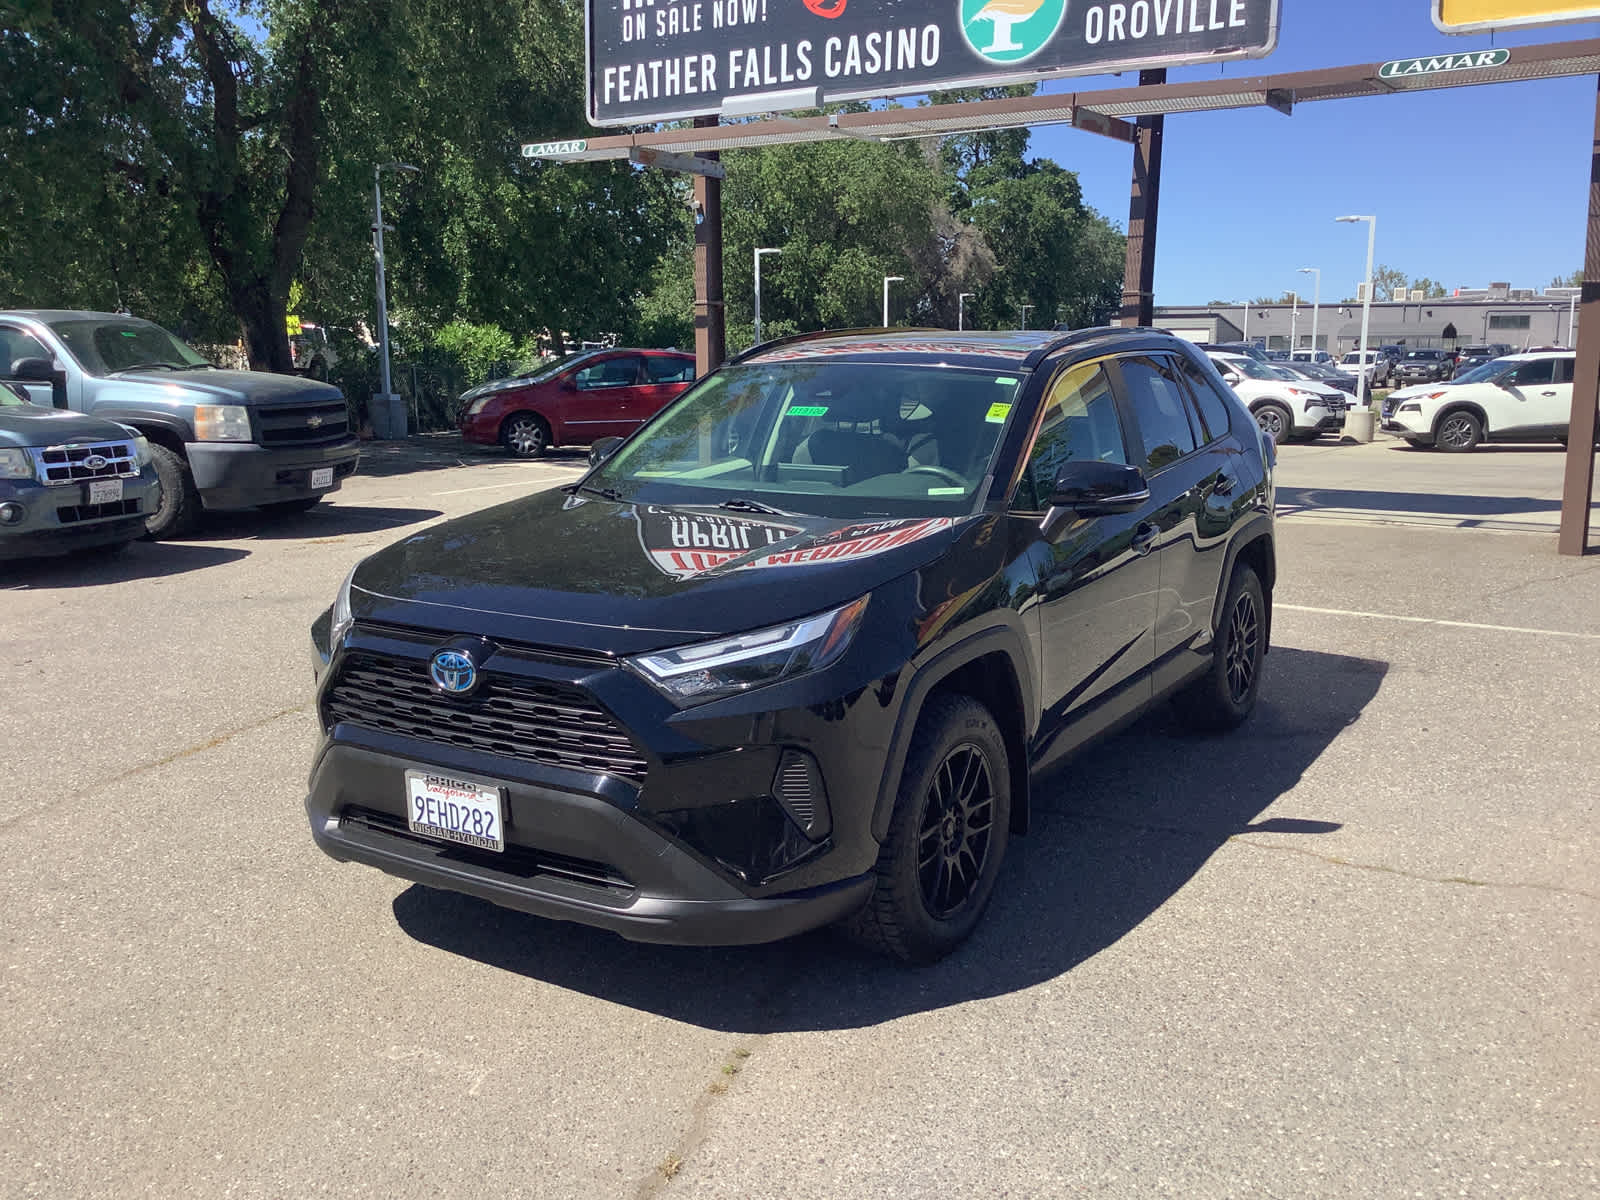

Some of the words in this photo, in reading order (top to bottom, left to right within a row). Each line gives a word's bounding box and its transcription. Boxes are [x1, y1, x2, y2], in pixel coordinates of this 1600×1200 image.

[623, 13, 646, 42] ON
[656, 3, 702, 37] SALE
[713, 0, 767, 29] NOW!
[1085, 0, 1246, 44] OROVILLE
[604, 54, 717, 105] FEATHER
[729, 40, 813, 90] FALLS
[824, 24, 941, 79] CASINO
[1389, 51, 1497, 76] LAMAR
[528, 142, 581, 155] LAMAR
[413, 822, 499, 850] NISSAN-HYUNDAI
[415, 795, 497, 839] 9EHD282
